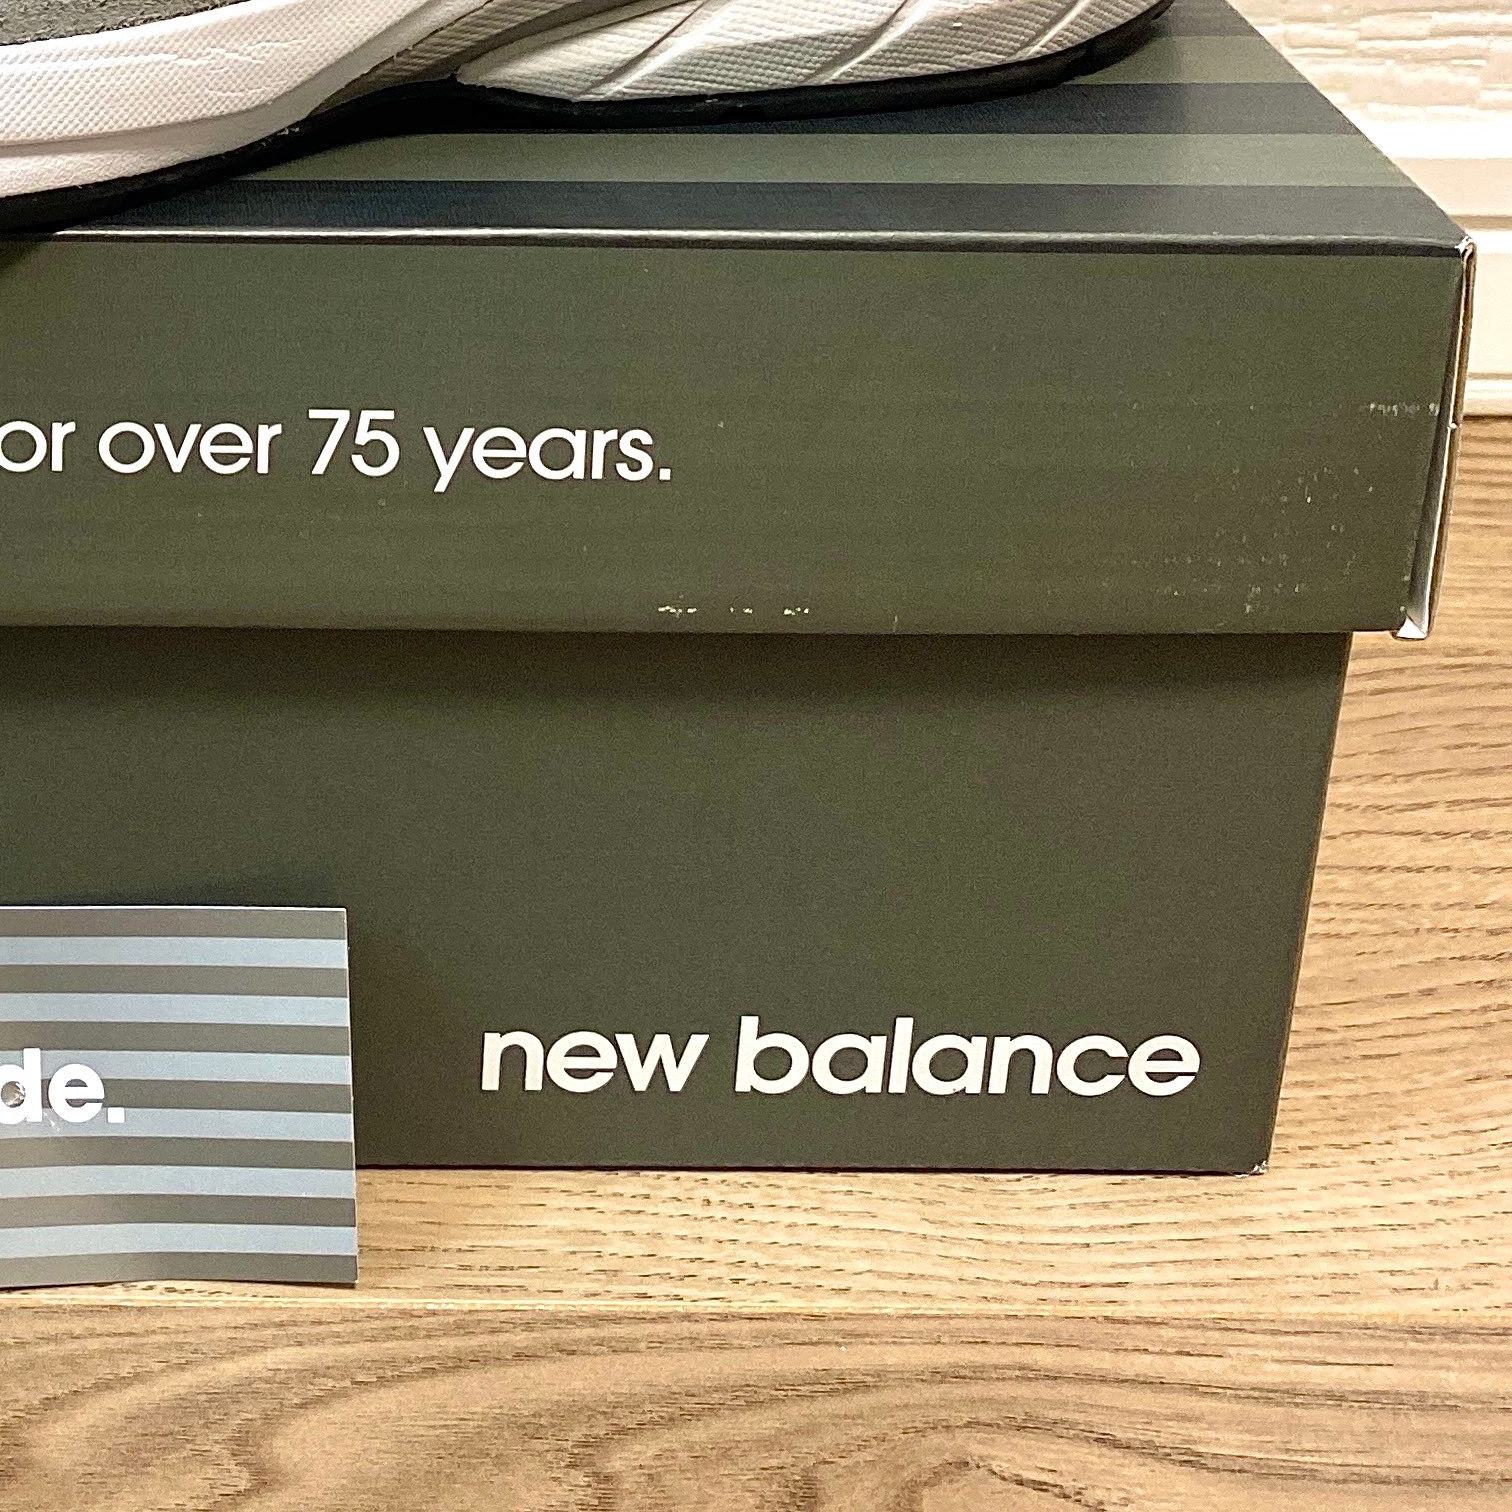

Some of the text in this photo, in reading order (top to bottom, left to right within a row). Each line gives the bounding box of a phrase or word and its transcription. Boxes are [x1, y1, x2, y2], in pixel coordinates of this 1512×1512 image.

[98, 421, 282, 475] over
[308, 408, 400, 477] 75
[422, 426, 672, 493] years.
[481, 1015, 1201, 1096] new balance
